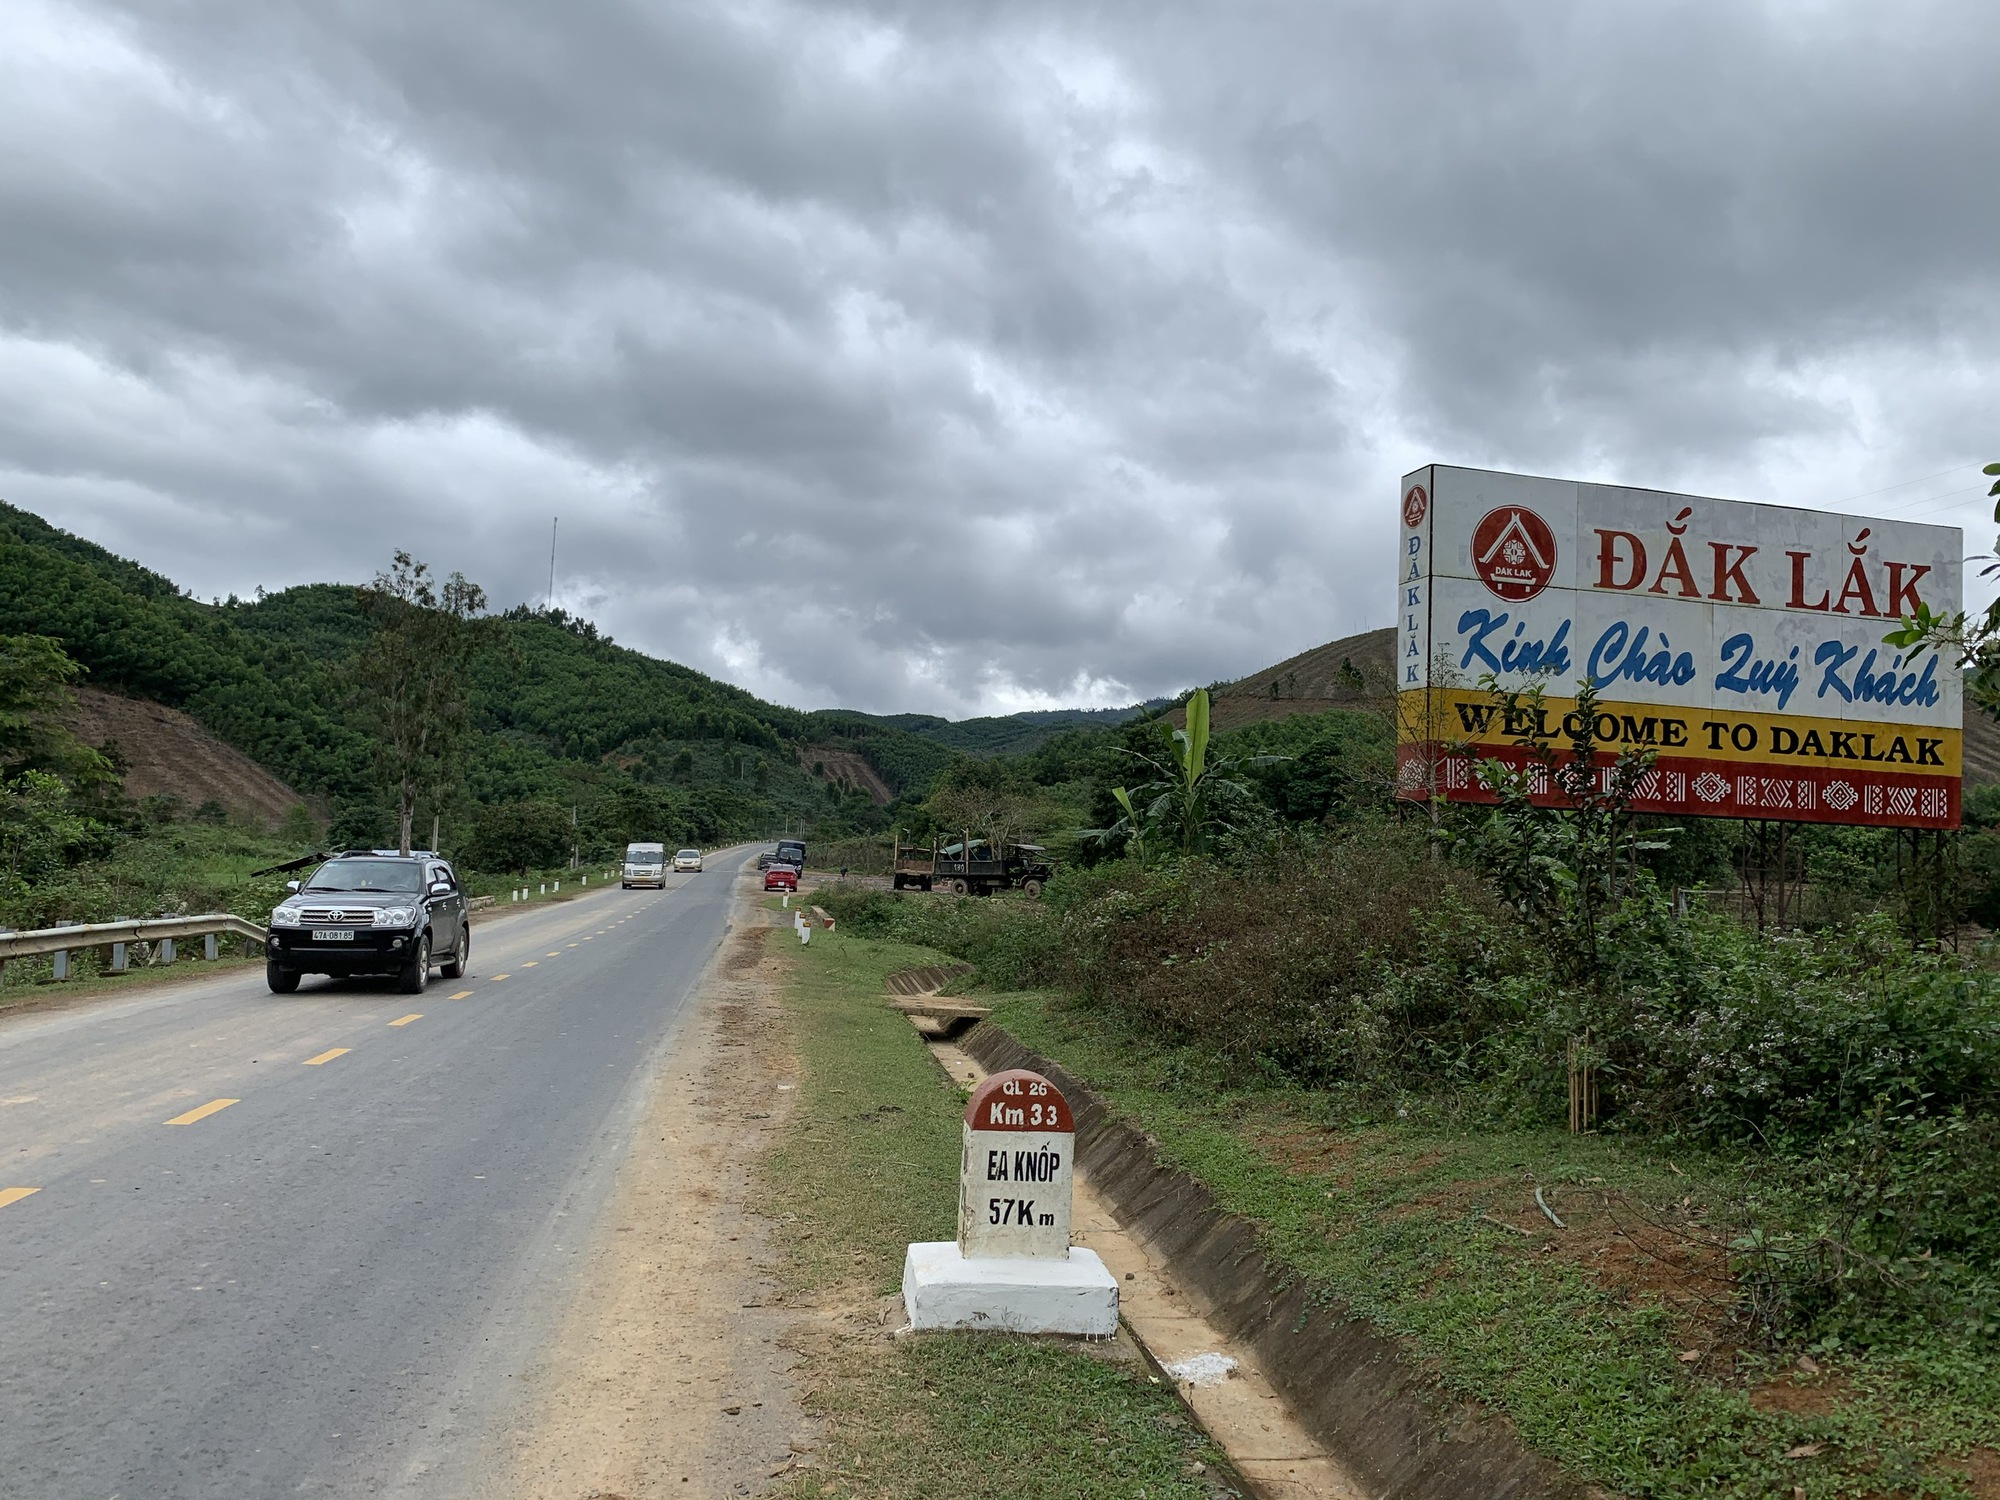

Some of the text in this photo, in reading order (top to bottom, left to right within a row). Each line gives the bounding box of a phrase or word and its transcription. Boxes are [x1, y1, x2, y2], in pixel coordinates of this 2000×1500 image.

[1495, 566, 1532, 578] DAK LAK
[1593, 506, 1931, 620] ĐẮK LẮK
[1457, 608, 1940, 711] Kính Chào Quý Khách
[1454, 702, 1945, 767] WELCOME TO DAKLAK
[1003, 1081, 1048, 1097] QL 26
[990, 1102, 1058, 1126] Km 33
[987, 1141, 1060, 1182] EA KNỐP
